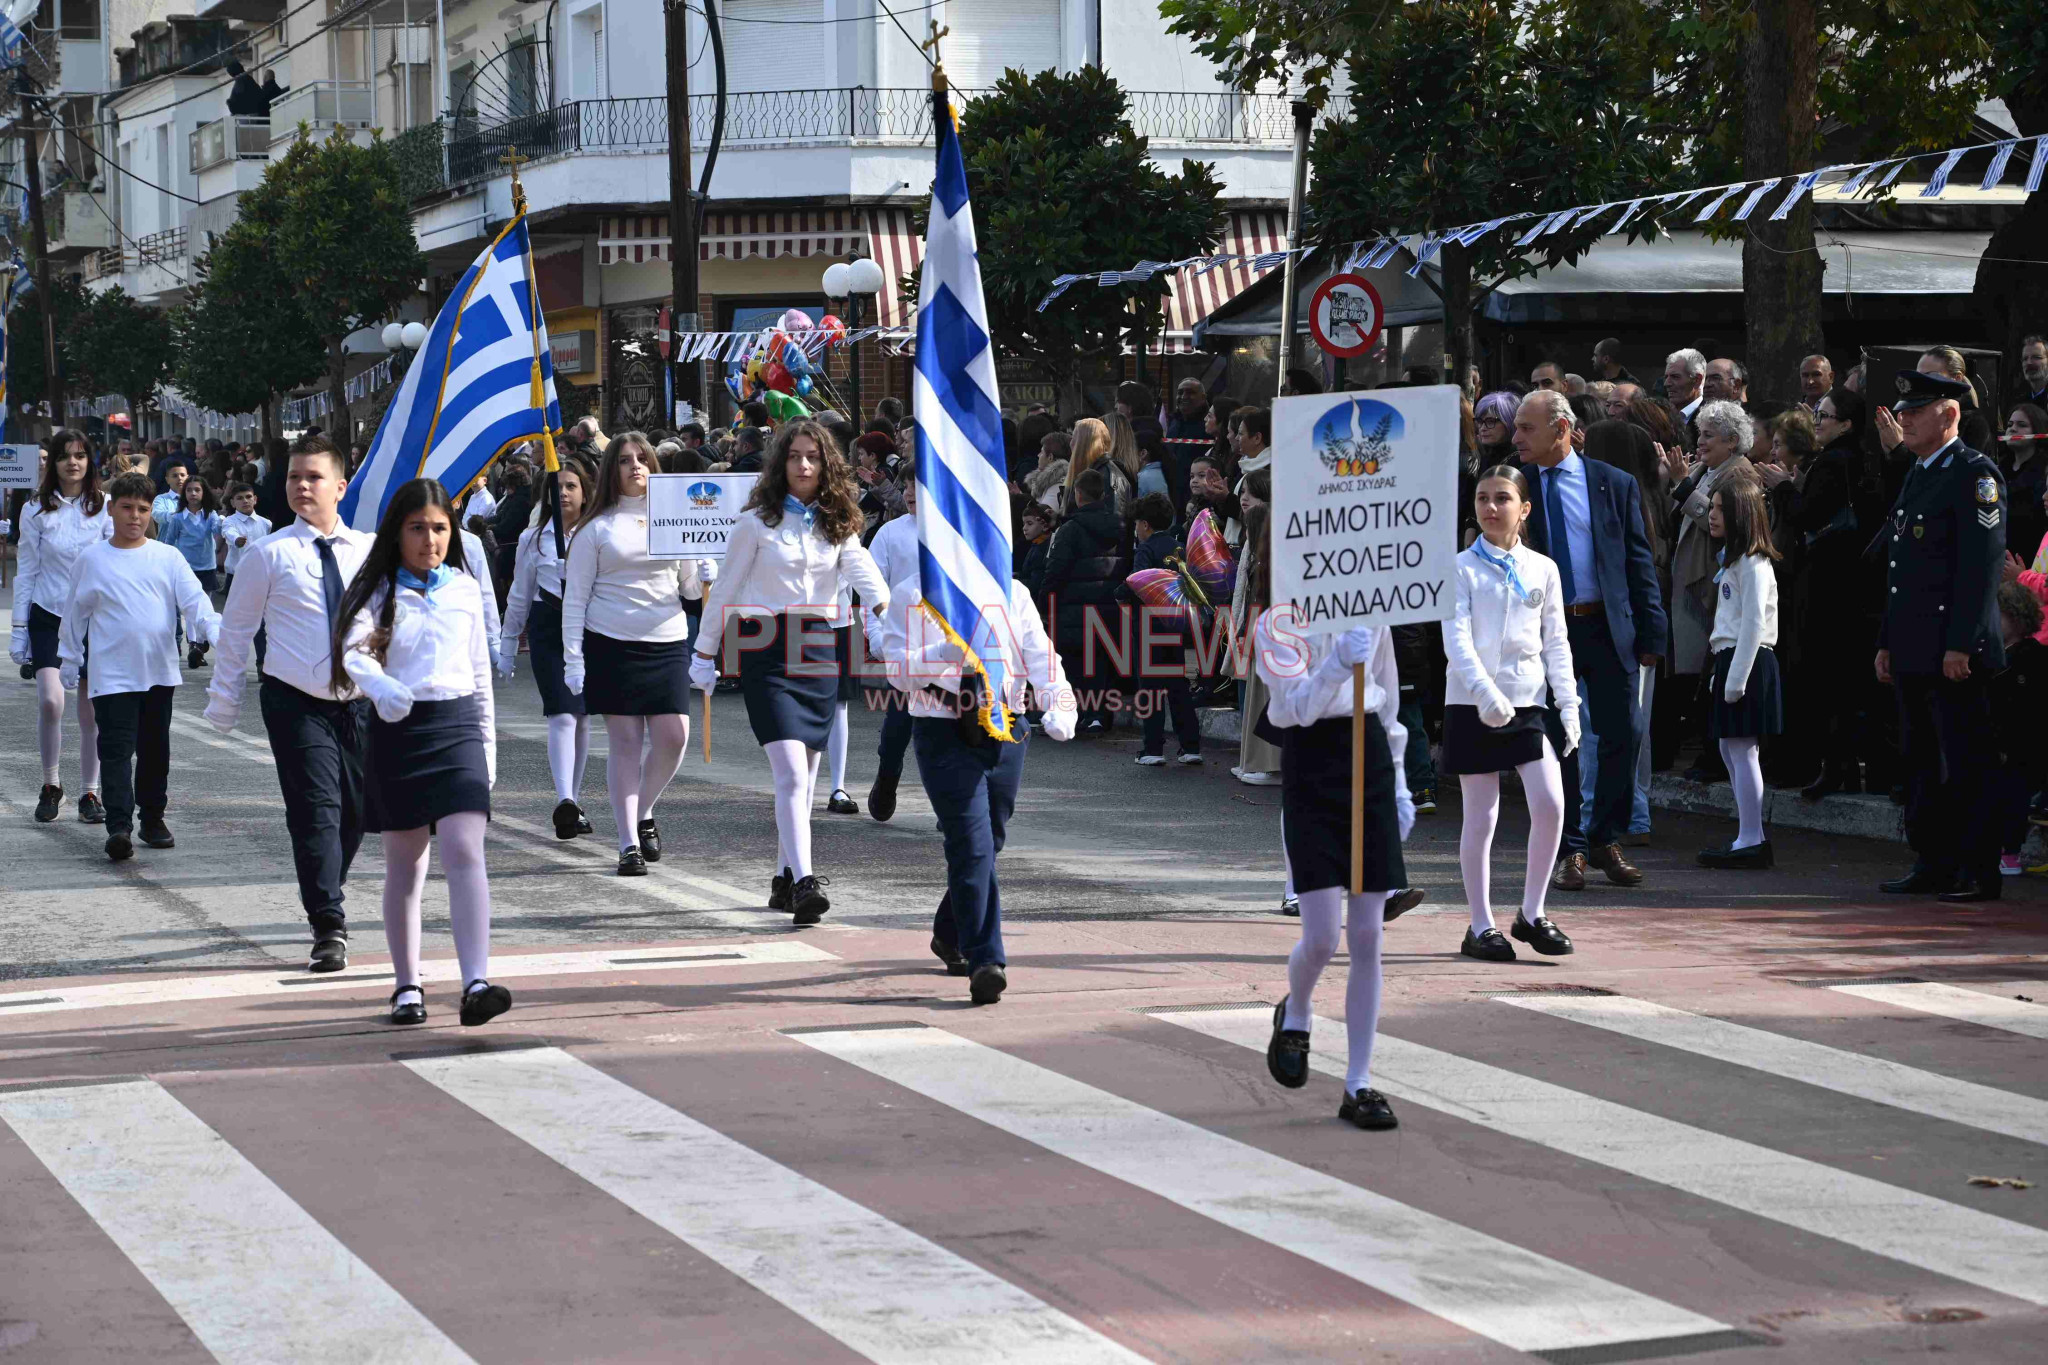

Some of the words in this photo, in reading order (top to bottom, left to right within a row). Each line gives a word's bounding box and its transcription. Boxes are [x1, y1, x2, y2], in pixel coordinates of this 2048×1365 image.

[1318, 480, 1354, 495] ΔΗΜΟΣ
[1357, 476, 1397, 491] ΣΚΥΔΡΑΣ
[652, 517, 709, 527] ΔΗΜΟΤΙΚΟ
[711, 517, 736, 527] ΣΧΟ
[1285, 498, 1432, 539] ΔΗΜΟΤΙΚΟ
[681, 530, 729, 544] ΡΙΖΟΥ
[1303, 541, 1423, 580] ΣΧΟΛΕΙΟ
[1291, 580, 1445, 625] ΜΑΝΔΑΛΟΥ
